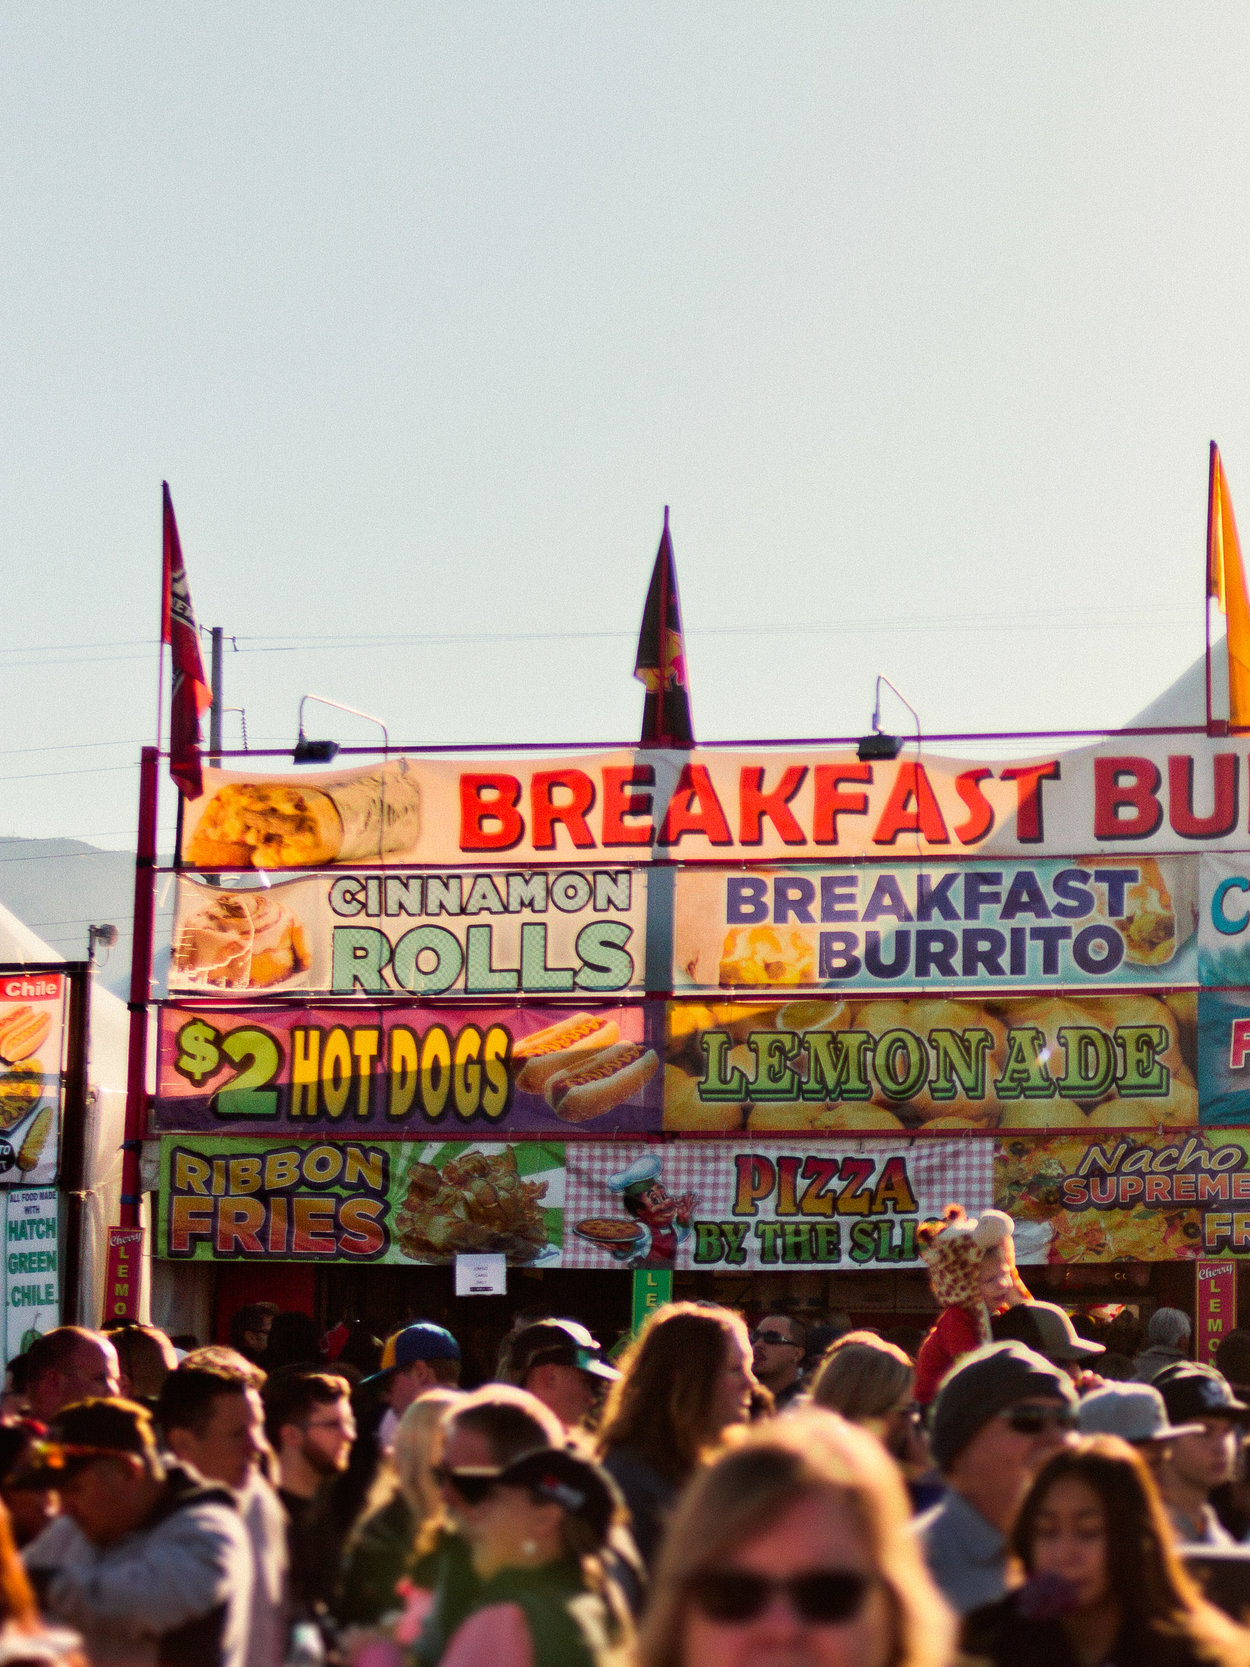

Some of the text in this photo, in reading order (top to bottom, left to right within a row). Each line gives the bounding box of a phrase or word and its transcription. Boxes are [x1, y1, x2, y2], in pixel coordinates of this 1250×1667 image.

[459, 761, 1061, 852] BREAKFAST
[329, 869, 633, 918] CINNAMON
[725, 868, 1139, 925] BREAKFAST
[331, 919, 635, 997] ROLLS
[818, 922, 1126, 980] BURRITO
[5, 981, 58, 997] Chile
[175, 1018, 513, 1121] $2 HOT DOGS
[700, 1025, 1170, 1101] LEMONADE
[171, 1143, 389, 1197] RIBBON
[1077, 1137, 1243, 1176] Nacho
[22, 1192, 38, 1202] FOOD
[40, 1190, 56, 1200] MADE
[732, 1154, 919, 1217] PIZZA
[9, 1217, 56, 1241] HATCH
[25, 1205, 40, 1215] WITH
[168, 1194, 391, 1260] FRIES
[8, 1251, 56, 1275] GREEN
[110, 1233, 141, 1247] Cherry
[694, 1217, 930, 1265] BY THE SLI
[11, 1284, 54, 1308] CHILE
[1198, 1264, 1233, 1281] Cherry
